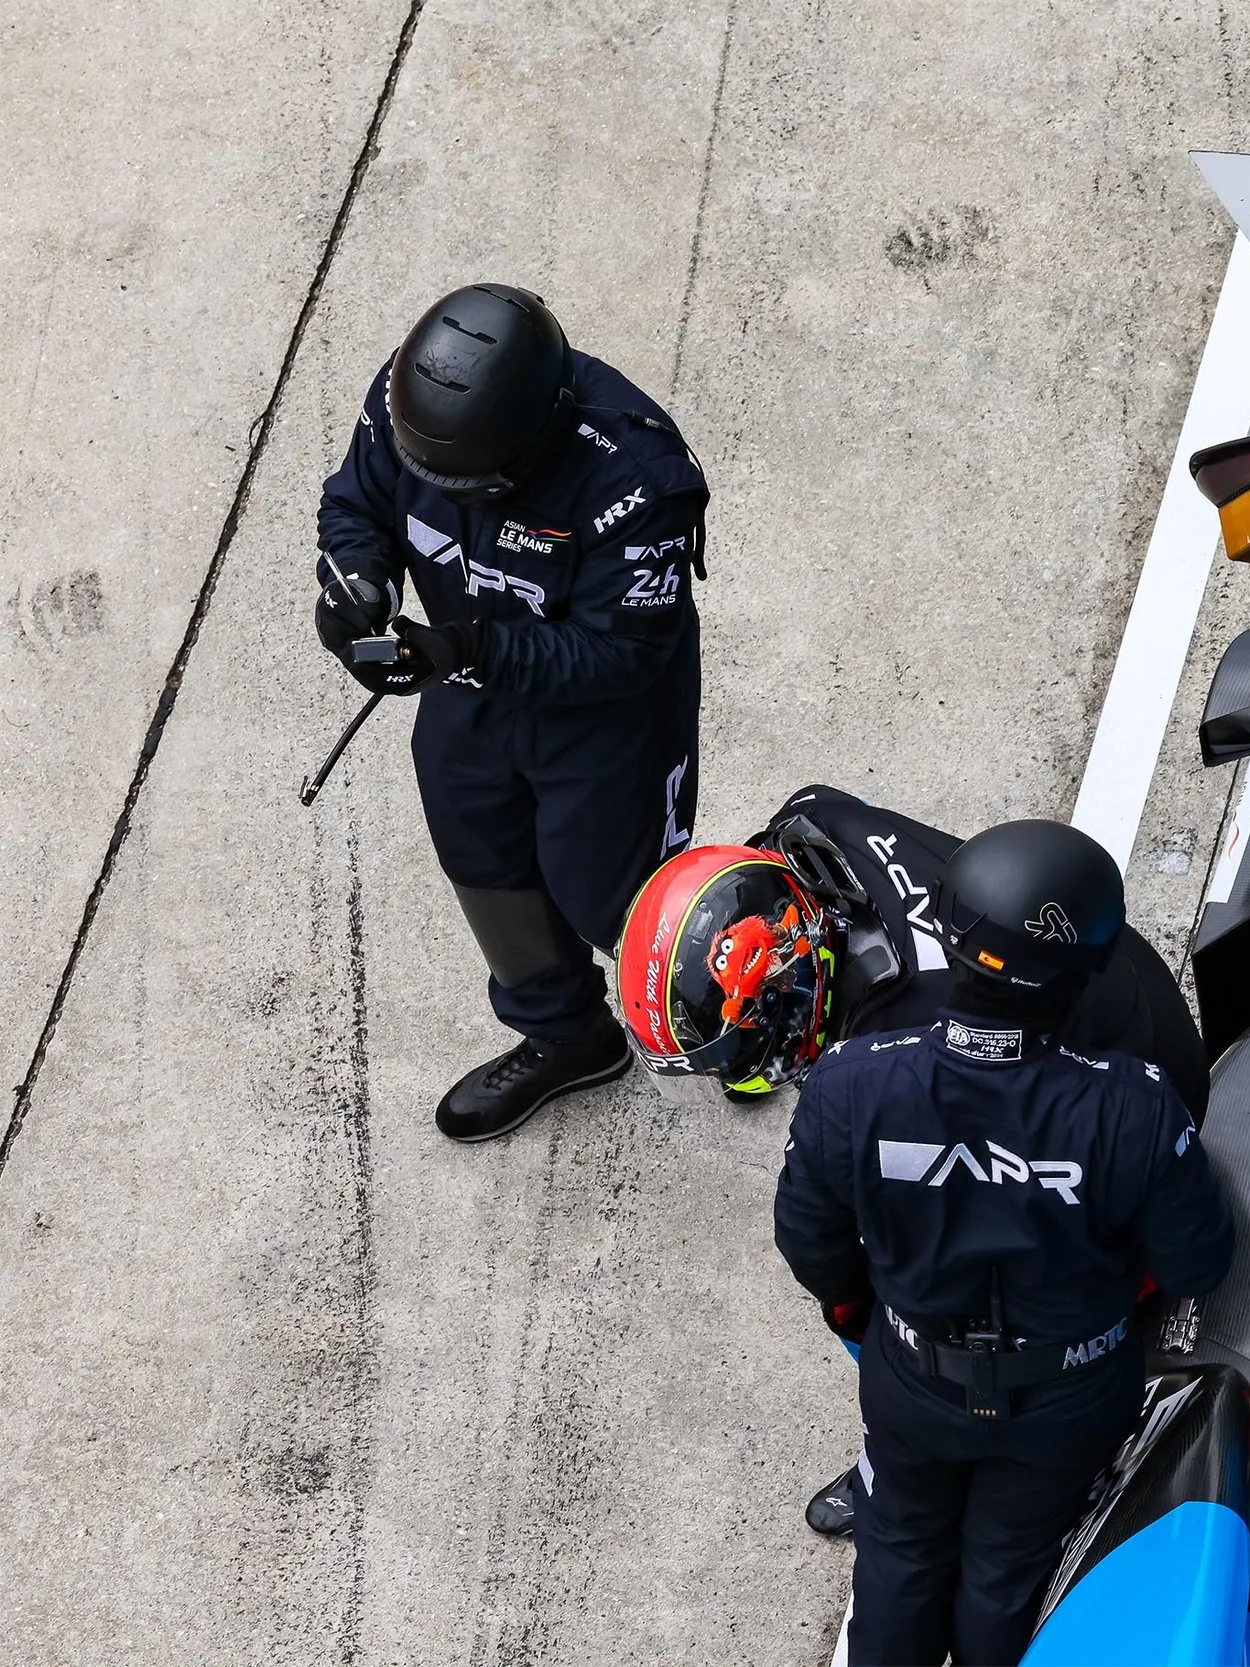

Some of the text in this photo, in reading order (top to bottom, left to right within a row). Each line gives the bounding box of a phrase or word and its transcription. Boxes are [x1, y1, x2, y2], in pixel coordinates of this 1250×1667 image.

[587, 431, 618, 454] APR
[593, 486, 646, 534] HRX
[503, 520, 526, 532] ASIAN
[496, 538, 522, 553] SERIES
[500, 528, 553, 554] LE MANS
[640, 536, 686, 560] APR
[433, 543, 545, 618] APR
[621, 594, 676, 607] LE MANS
[386, 674, 414, 683] HRX
[867, 834, 933, 932] APR
[646, 959, 660, 1005] With
[928, 1139, 1083, 1205] APR
[1062, 1316, 1127, 1370] MRTC
